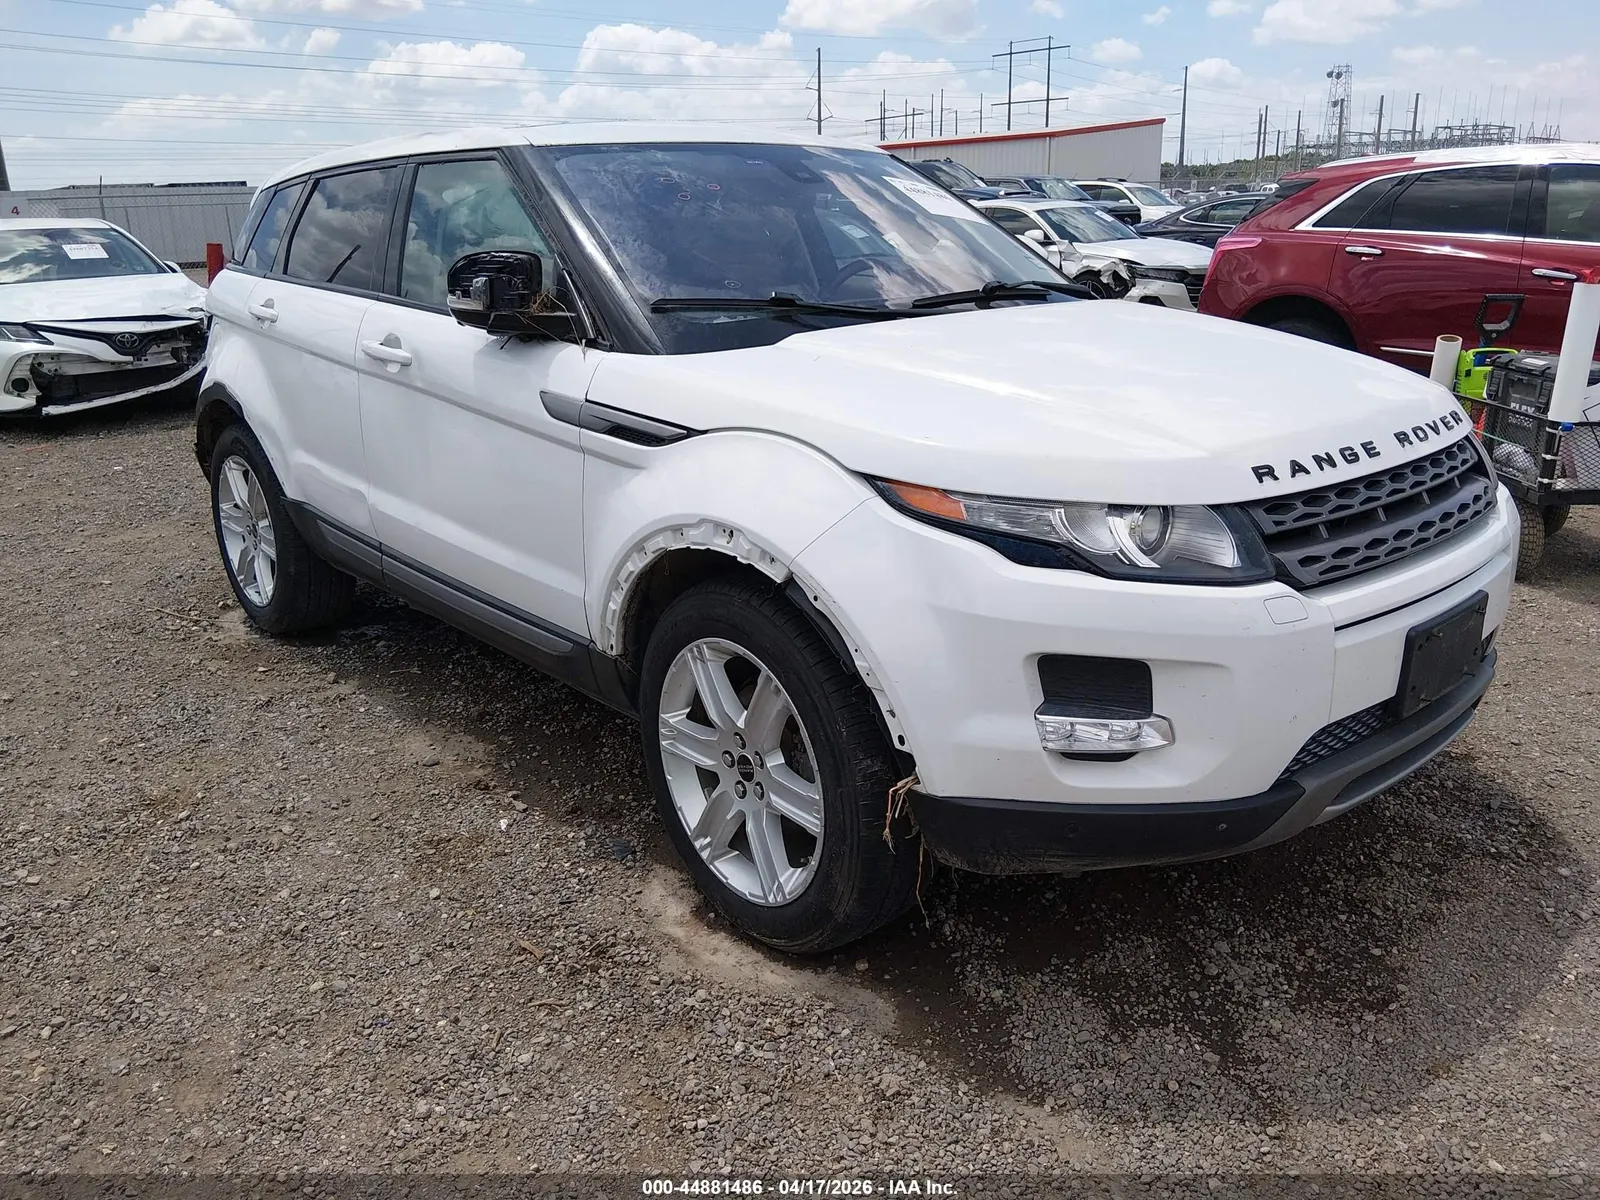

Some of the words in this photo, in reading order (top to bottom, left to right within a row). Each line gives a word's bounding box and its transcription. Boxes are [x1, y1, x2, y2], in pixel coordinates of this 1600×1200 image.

[11, 206, 20, 215] 4
[1251, 440, 1381, 484] RANGE
[1393, 409, 1464, 449] ROVER
